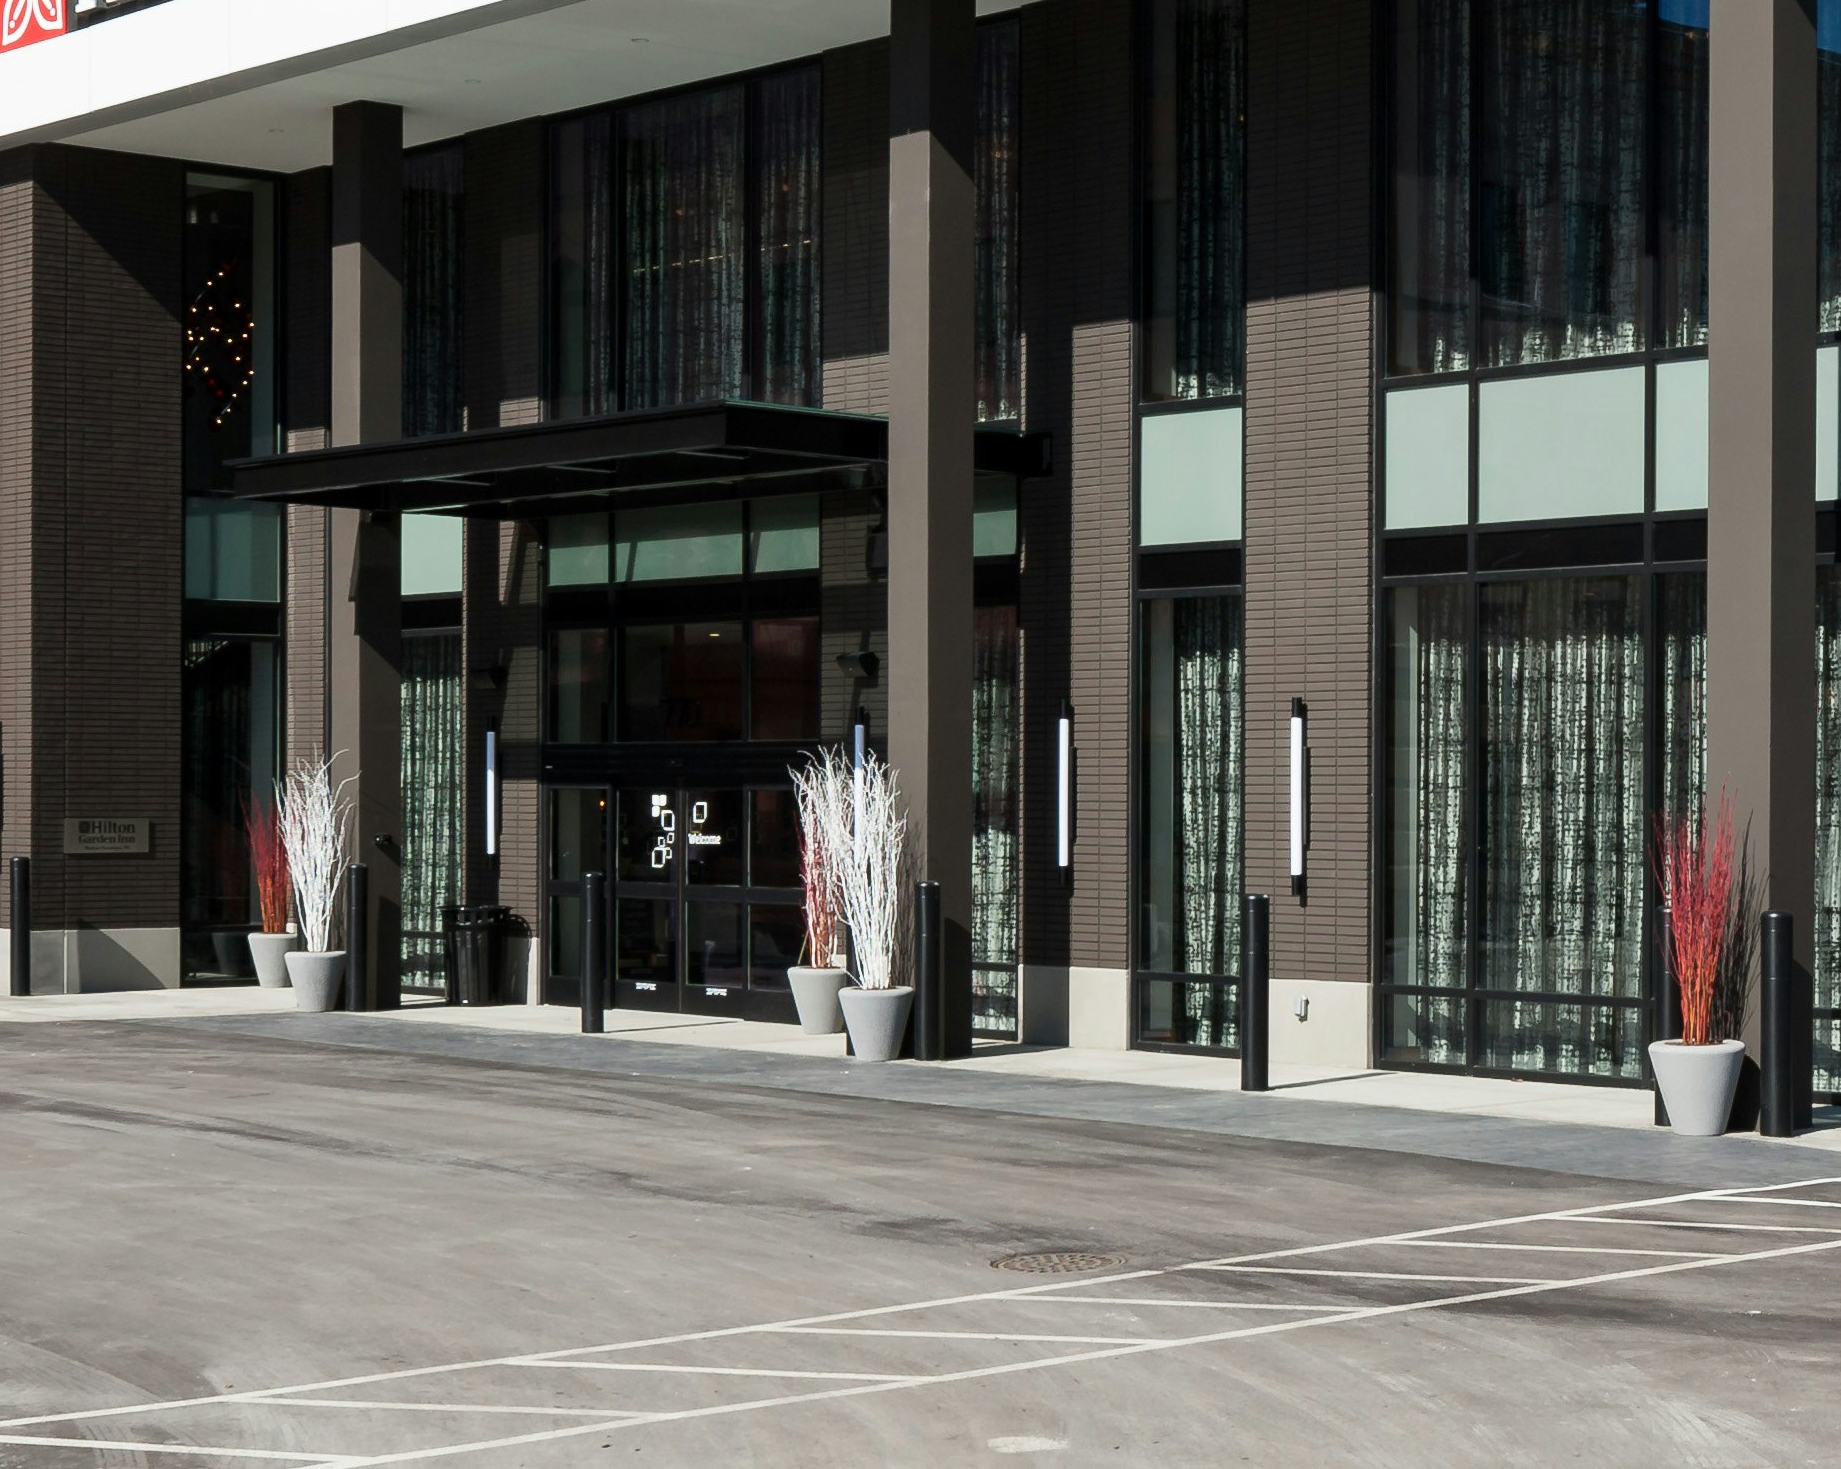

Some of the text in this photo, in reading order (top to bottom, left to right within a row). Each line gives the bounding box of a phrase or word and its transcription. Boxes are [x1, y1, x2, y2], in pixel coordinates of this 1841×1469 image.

[91, 821, 136, 834] Hilton
[78, 834, 136, 844] Garden Inn
